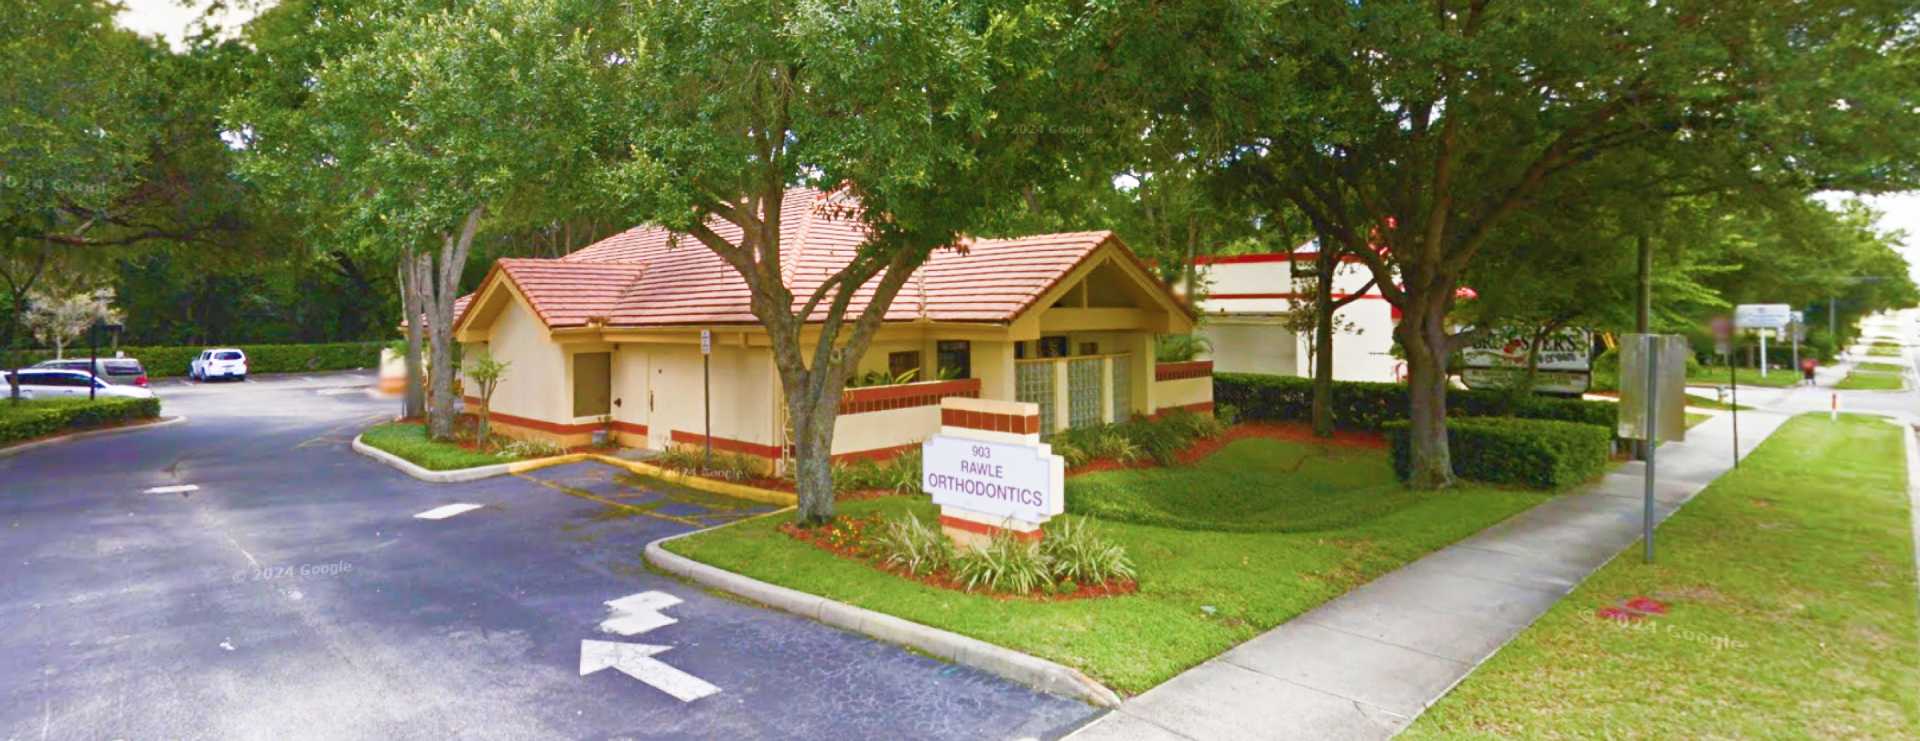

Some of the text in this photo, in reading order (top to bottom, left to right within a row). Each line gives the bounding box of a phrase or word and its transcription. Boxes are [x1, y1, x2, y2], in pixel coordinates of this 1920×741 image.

[971, 445, 991, 459] 903
[960, 460, 1004, 479] RAWLE
[928, 473, 1043, 507] ORTHODONTICS
